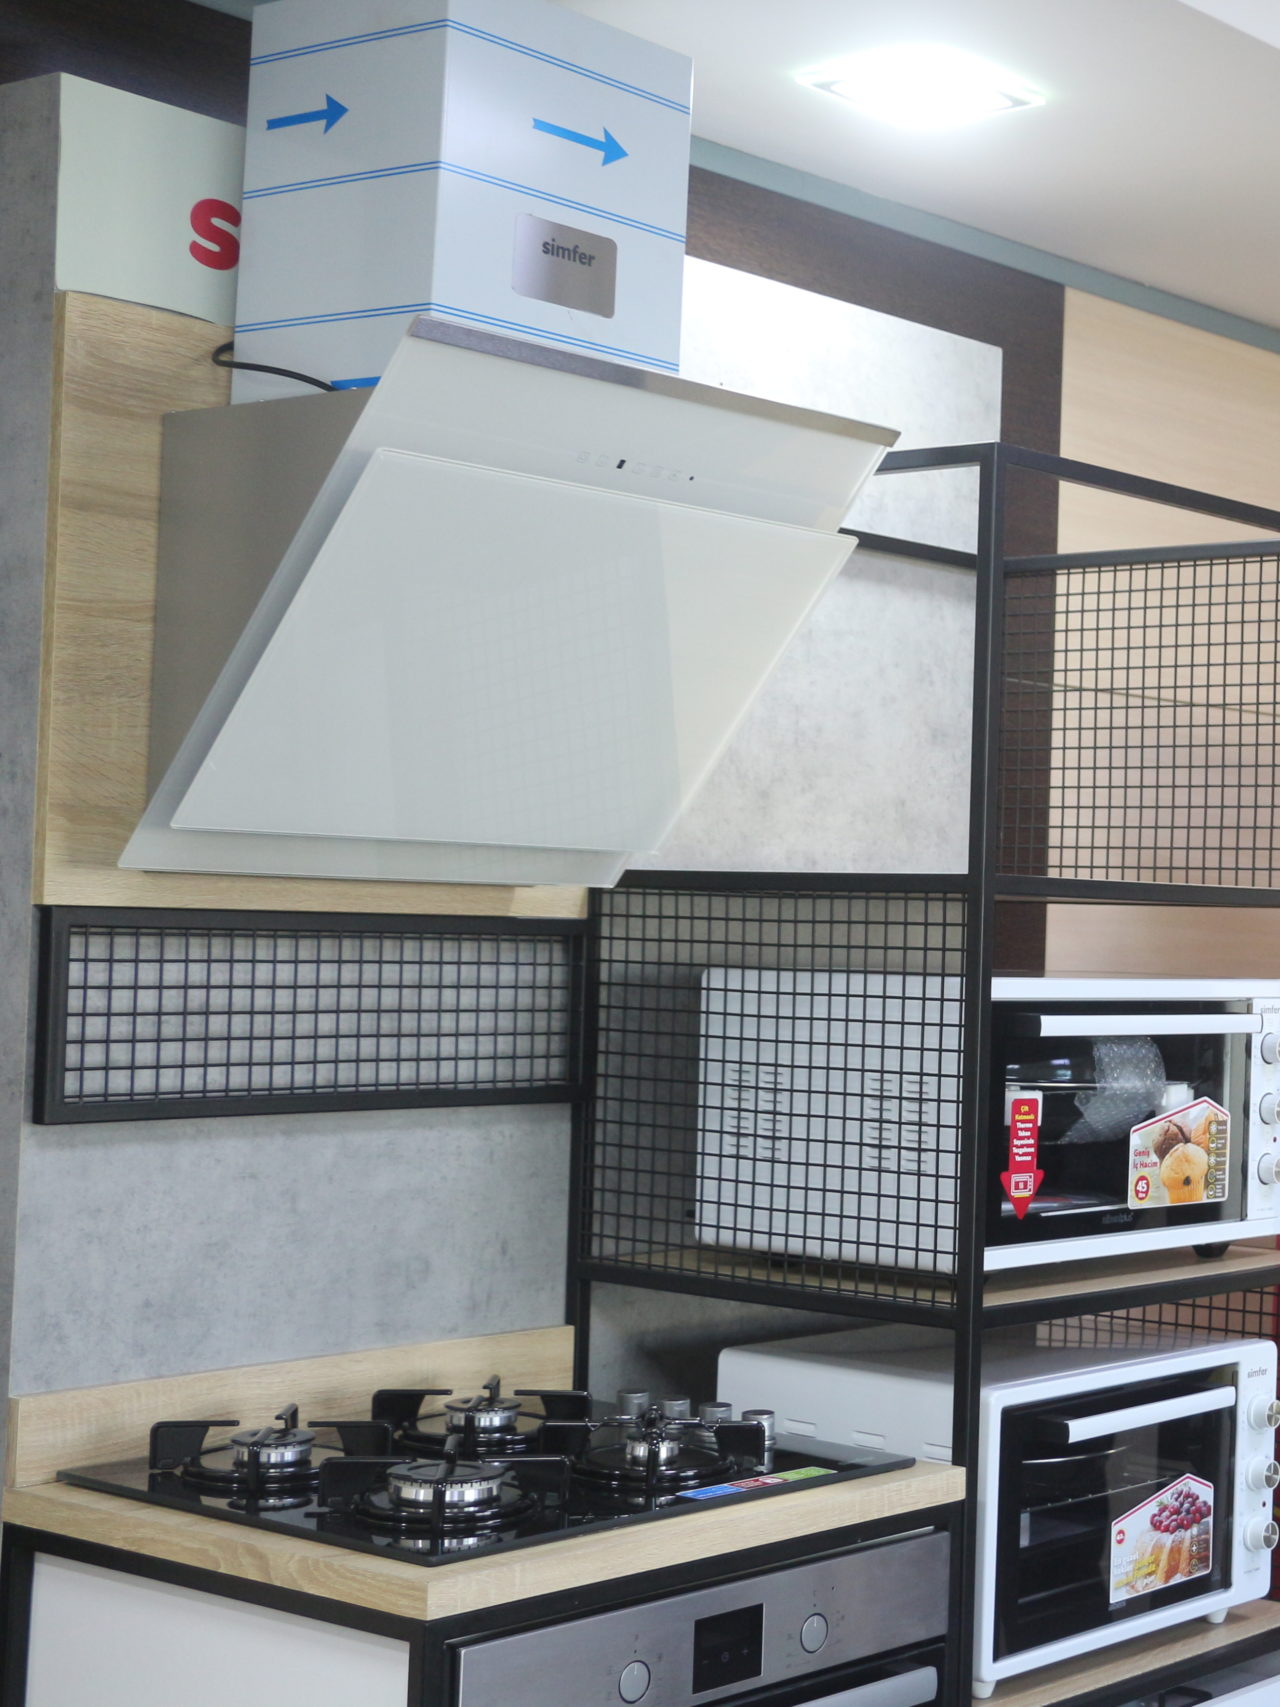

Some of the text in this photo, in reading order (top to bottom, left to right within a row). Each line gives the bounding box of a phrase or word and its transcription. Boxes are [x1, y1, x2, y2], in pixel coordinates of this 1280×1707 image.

[542, 238, 596, 267] simfer
[1260, 1004, 1280, 1015] simfer
[1133, 1148, 1150, 1158] Geniş
[1140, 1160, 1158, 1169] Hacim
[1136, 1180, 1148, 1192] 45
[1247, 1366, 1268, 1379] simfer
